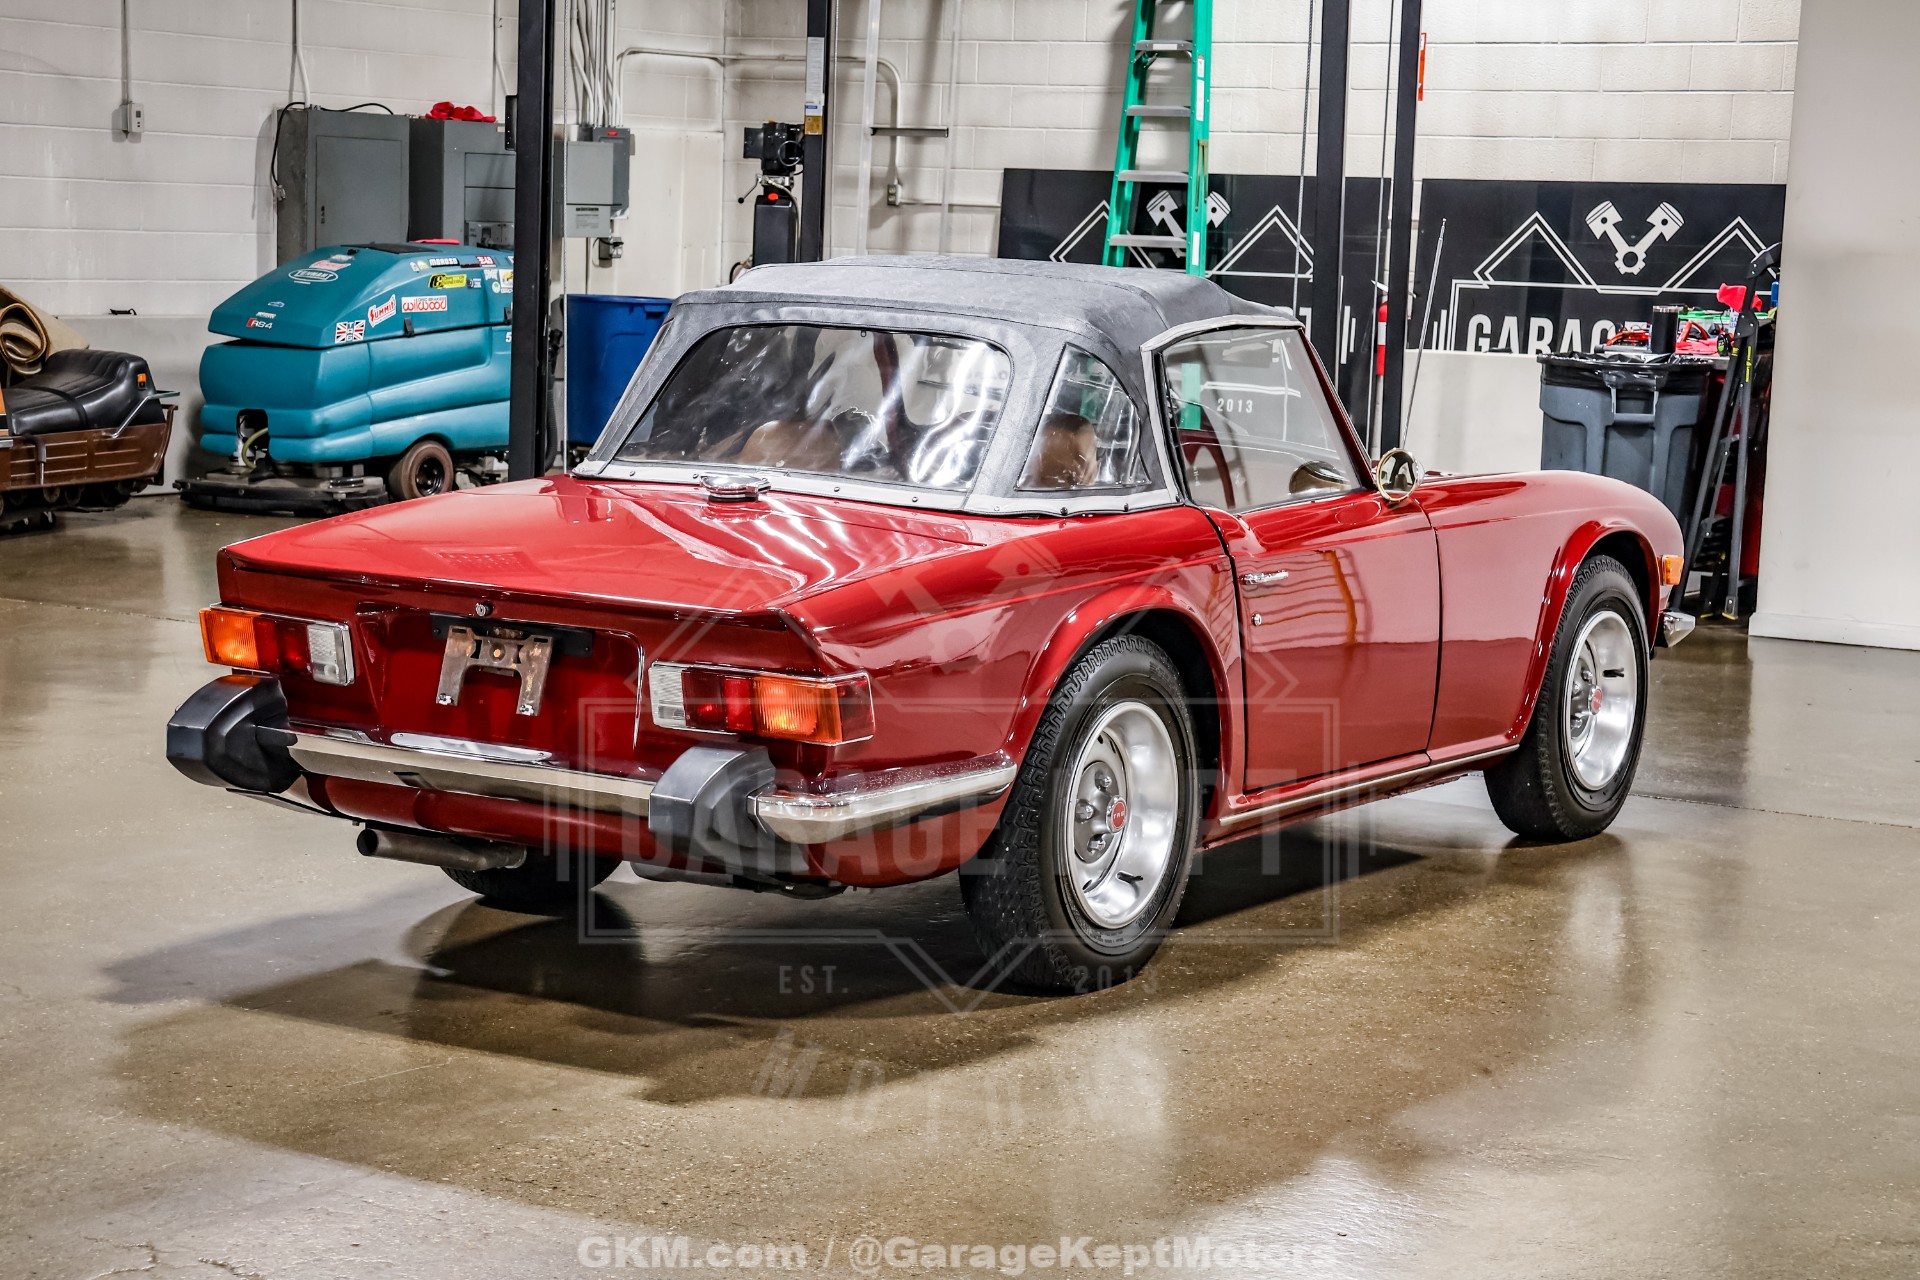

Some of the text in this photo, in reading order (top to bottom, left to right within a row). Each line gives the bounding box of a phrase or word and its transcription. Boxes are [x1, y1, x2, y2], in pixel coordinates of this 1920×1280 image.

[369, 300, 396, 322] SUMMIT
[402, 297, 447, 311] wilwood
[1467, 313, 1649, 354] GARAG
[1216, 398, 1253, 413] 2013
